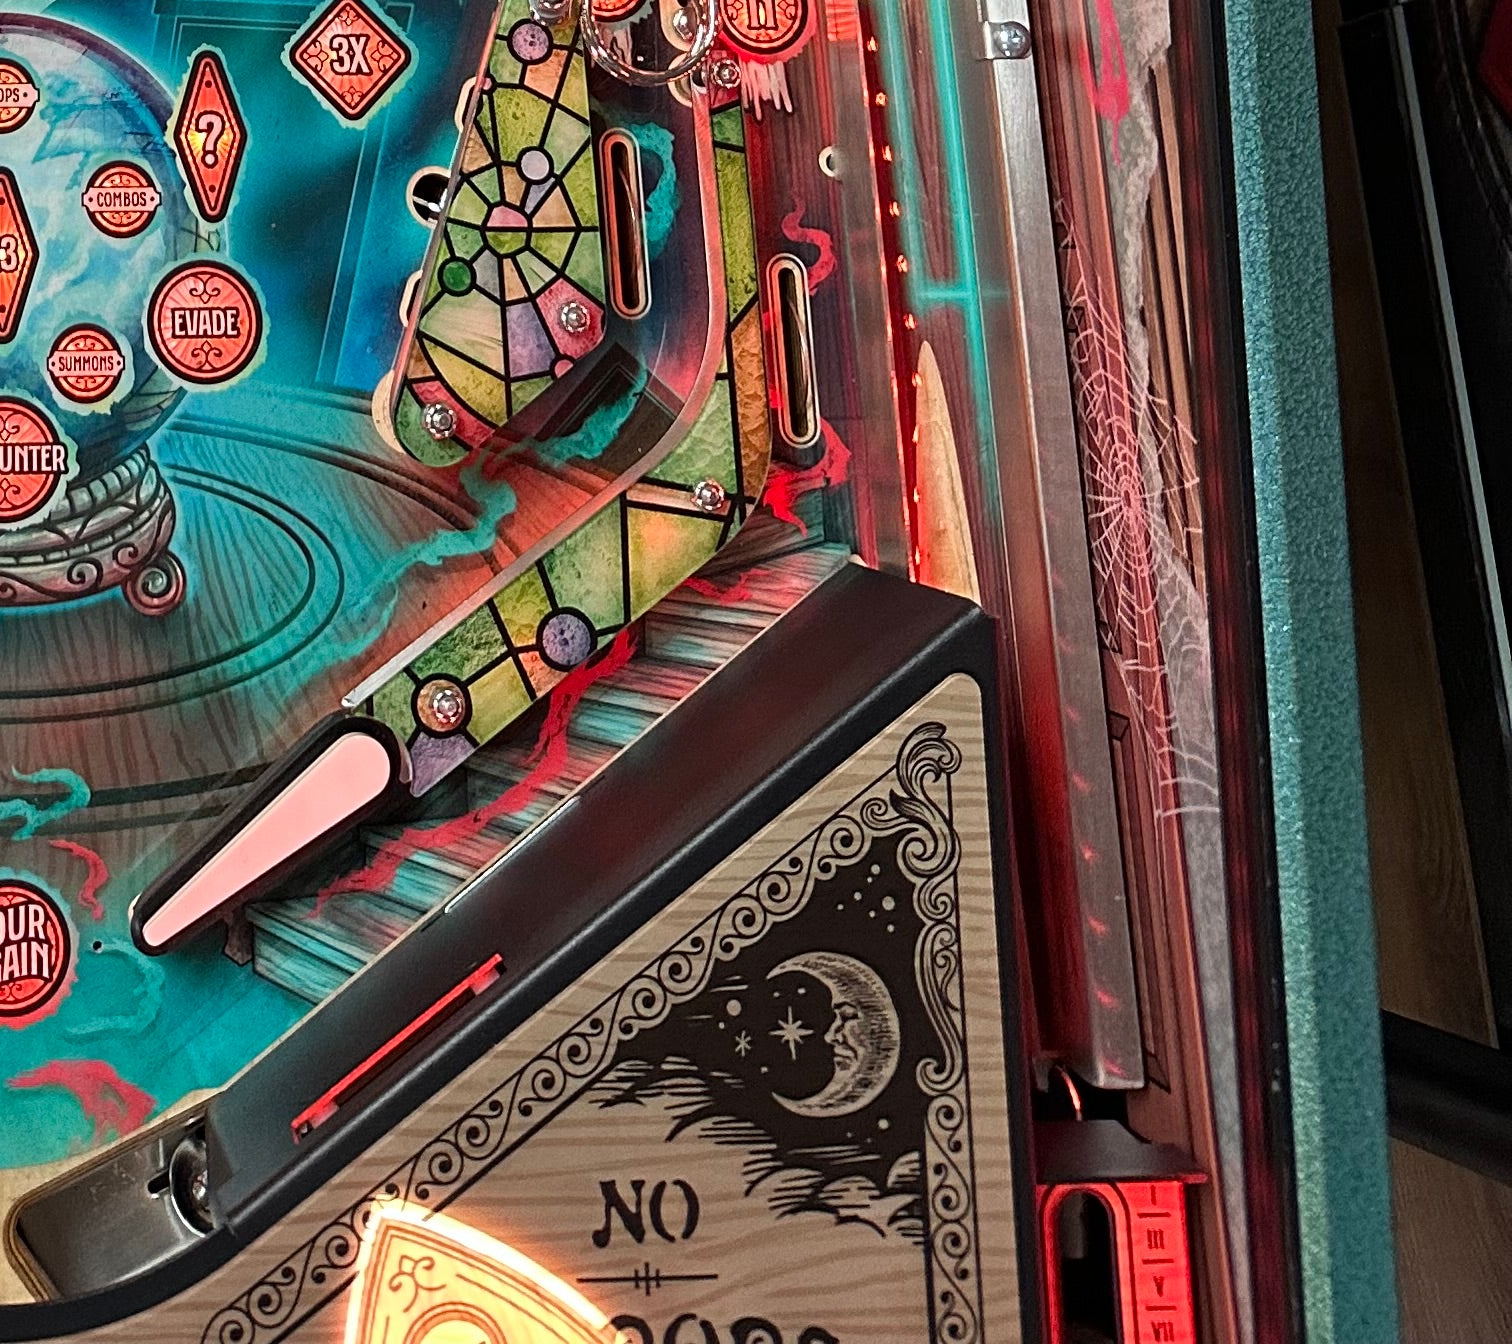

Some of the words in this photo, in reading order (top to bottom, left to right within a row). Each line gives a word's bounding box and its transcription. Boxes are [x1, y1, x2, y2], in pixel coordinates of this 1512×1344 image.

[329, 33, 370, 77] 3X
[95, 191, 147, 208] COMBOS
[174, 310, 240, 336] EVADE
[57, 356, 115, 372] SUMMONS
[591, 1178, 701, 1249] NO
